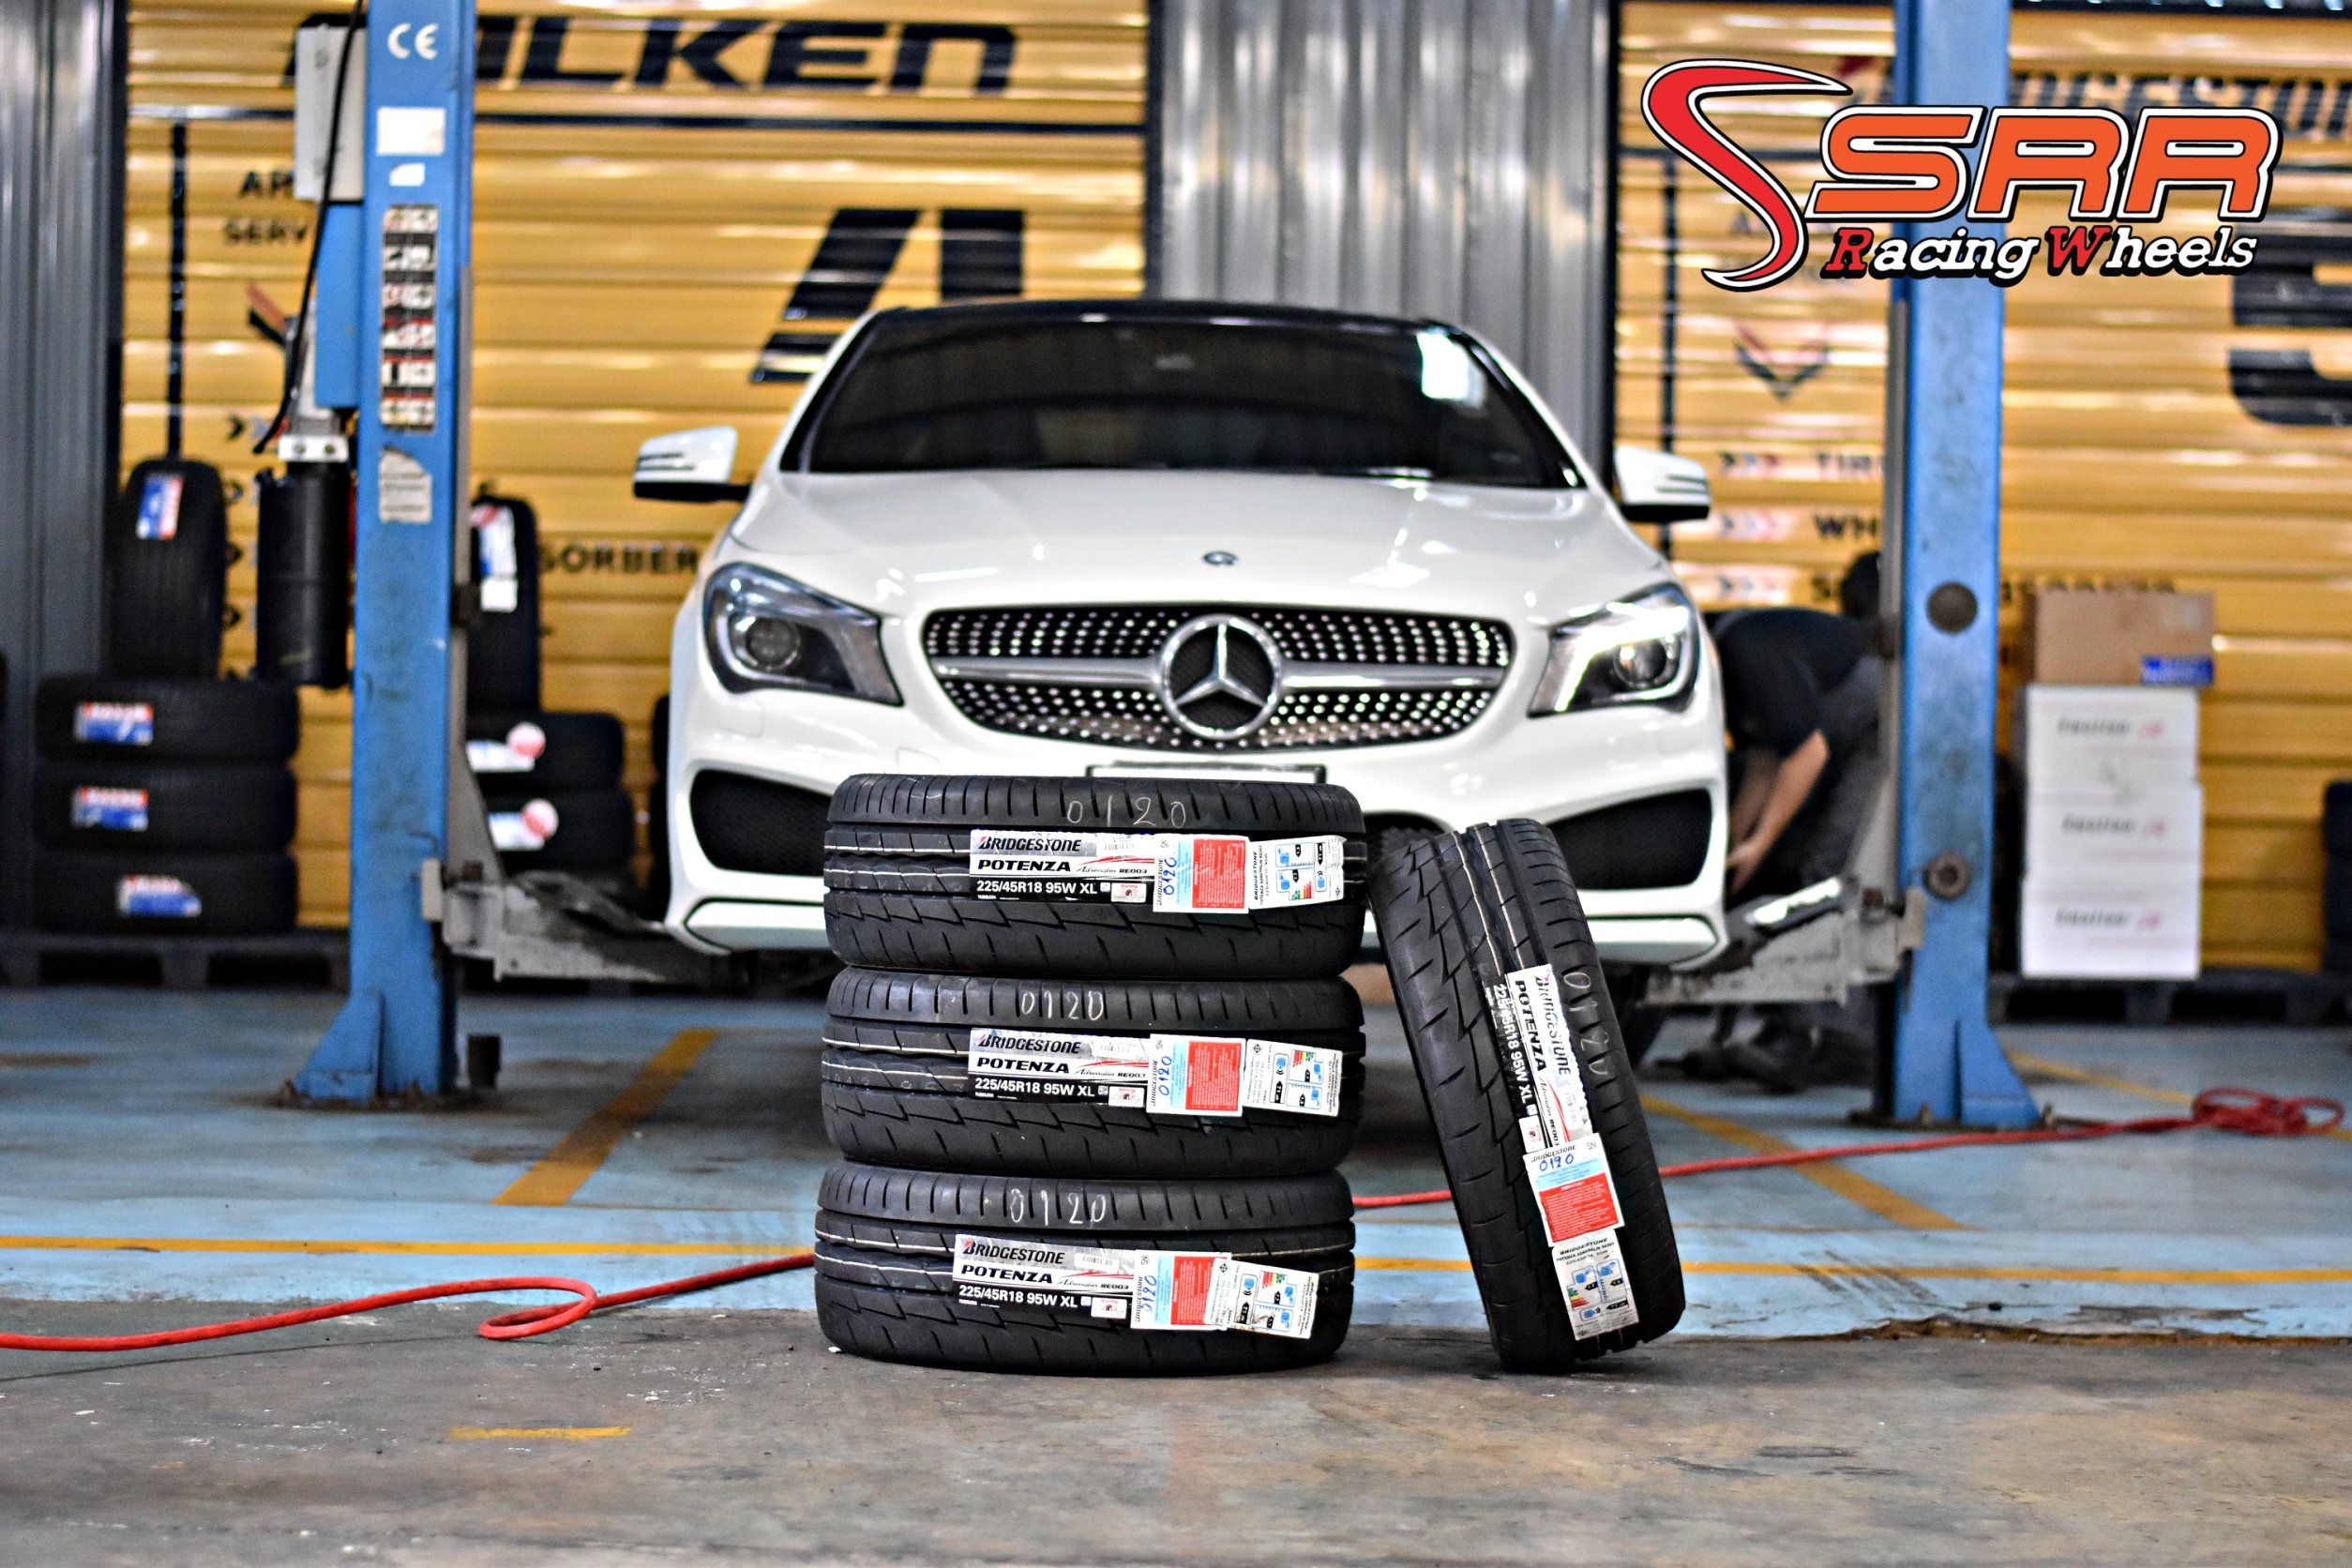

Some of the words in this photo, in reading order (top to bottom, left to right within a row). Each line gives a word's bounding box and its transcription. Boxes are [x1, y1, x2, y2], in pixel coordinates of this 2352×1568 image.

[387, 23, 439, 60] CE
[224, 219, 308, 246] SERV
[978, 837, 1081, 852] BRIDGESTONE
[977, 859, 1071, 872] POTENZA
[977, 881, 1043, 894] 225/45R18
[1046, 882, 1077, 894] 95W
[1079, 882, 1098, 895] XL
[1021, 991, 1105, 1020] 0120
[1493, 984, 1519, 1049] 225/45R18
[1515, 980, 1546, 1072] POTENZA
[1534, 975, 1571, 1076] BRIDGESTONE
[978, 1034, 1081, 1054] BRIDGESTONE
[977, 1057, 1069, 1074] POTENZA
[1511, 1051, 1529, 1083] 95W
[975, 1078, 1040, 1093] 225/45R18
[1044, 1082, 1075, 1095] 95W
[1078, 1085, 1095, 1097] XL
[1150, 1059, 1158, 1108] BRIDGESTONE
[1519, 1083, 1533, 1104] XL
[963, 1241, 1065, 1264] BRIDGESTONE
[1560, 1238, 1608, 1256] BRIDGESTONE
[961, 1264, 1052, 1284] POTENZA
[958, 1285, 1023, 1303] 225/45R18
[1027, 1292, 1058, 1306] 95W
[1060, 1295, 1078, 1307] XL
[1135, 1275, 1143, 1322] BRIDGESTONE
